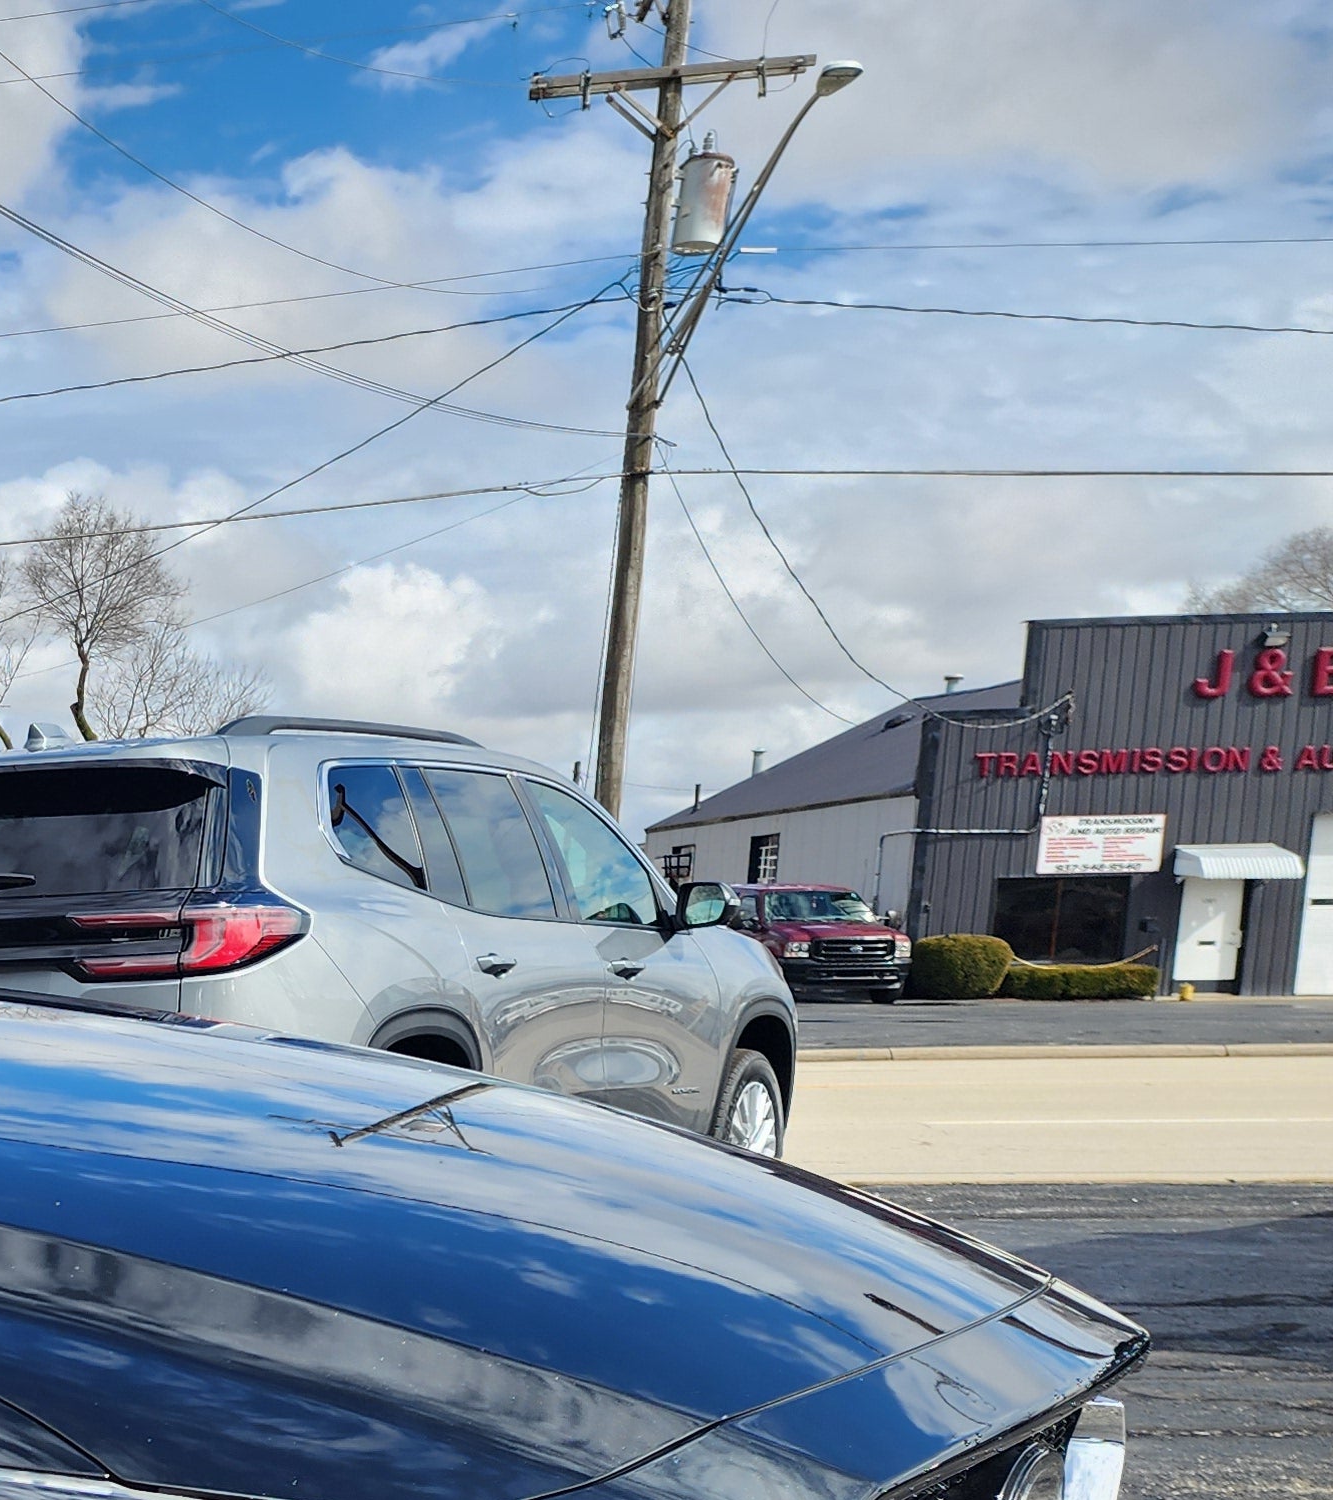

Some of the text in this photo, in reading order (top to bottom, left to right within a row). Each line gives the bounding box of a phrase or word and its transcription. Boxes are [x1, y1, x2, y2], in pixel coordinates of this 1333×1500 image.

[1195, 648, 1234, 697] J
[1249, 648, 1293, 697] &
[975, 747, 1250, 777] TRANSMISSION
[1260, 745, 1284, 771] &
